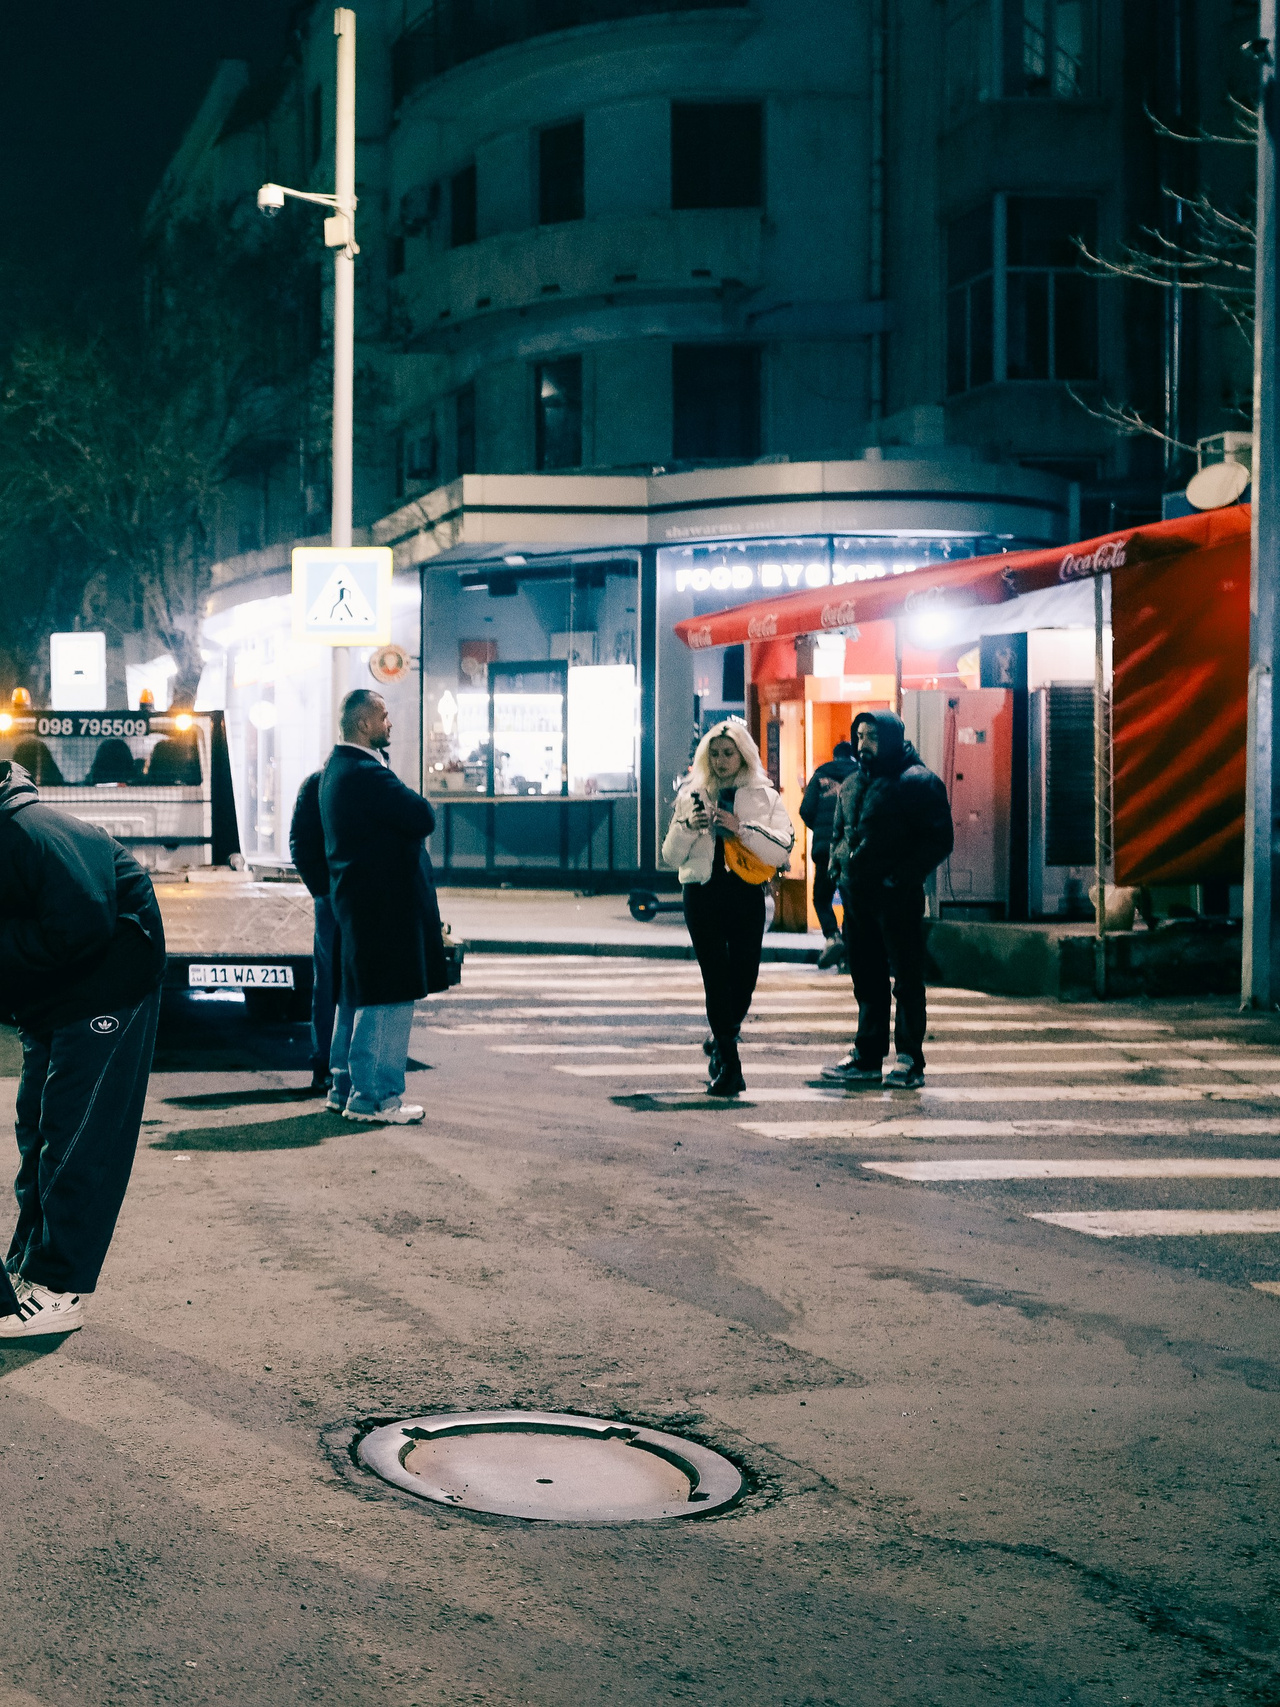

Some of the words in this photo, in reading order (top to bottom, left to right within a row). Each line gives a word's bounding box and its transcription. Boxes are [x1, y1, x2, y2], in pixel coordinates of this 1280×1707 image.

[676, 565, 753, 592] FOOD
[761, 564, 804, 587] BY
[38, 718, 73, 735] 098
[79, 718, 147, 736] 795509
[211, 968, 228, 982] 11
[234, 968, 255, 983] WA
[261, 968, 289, 984] 211
